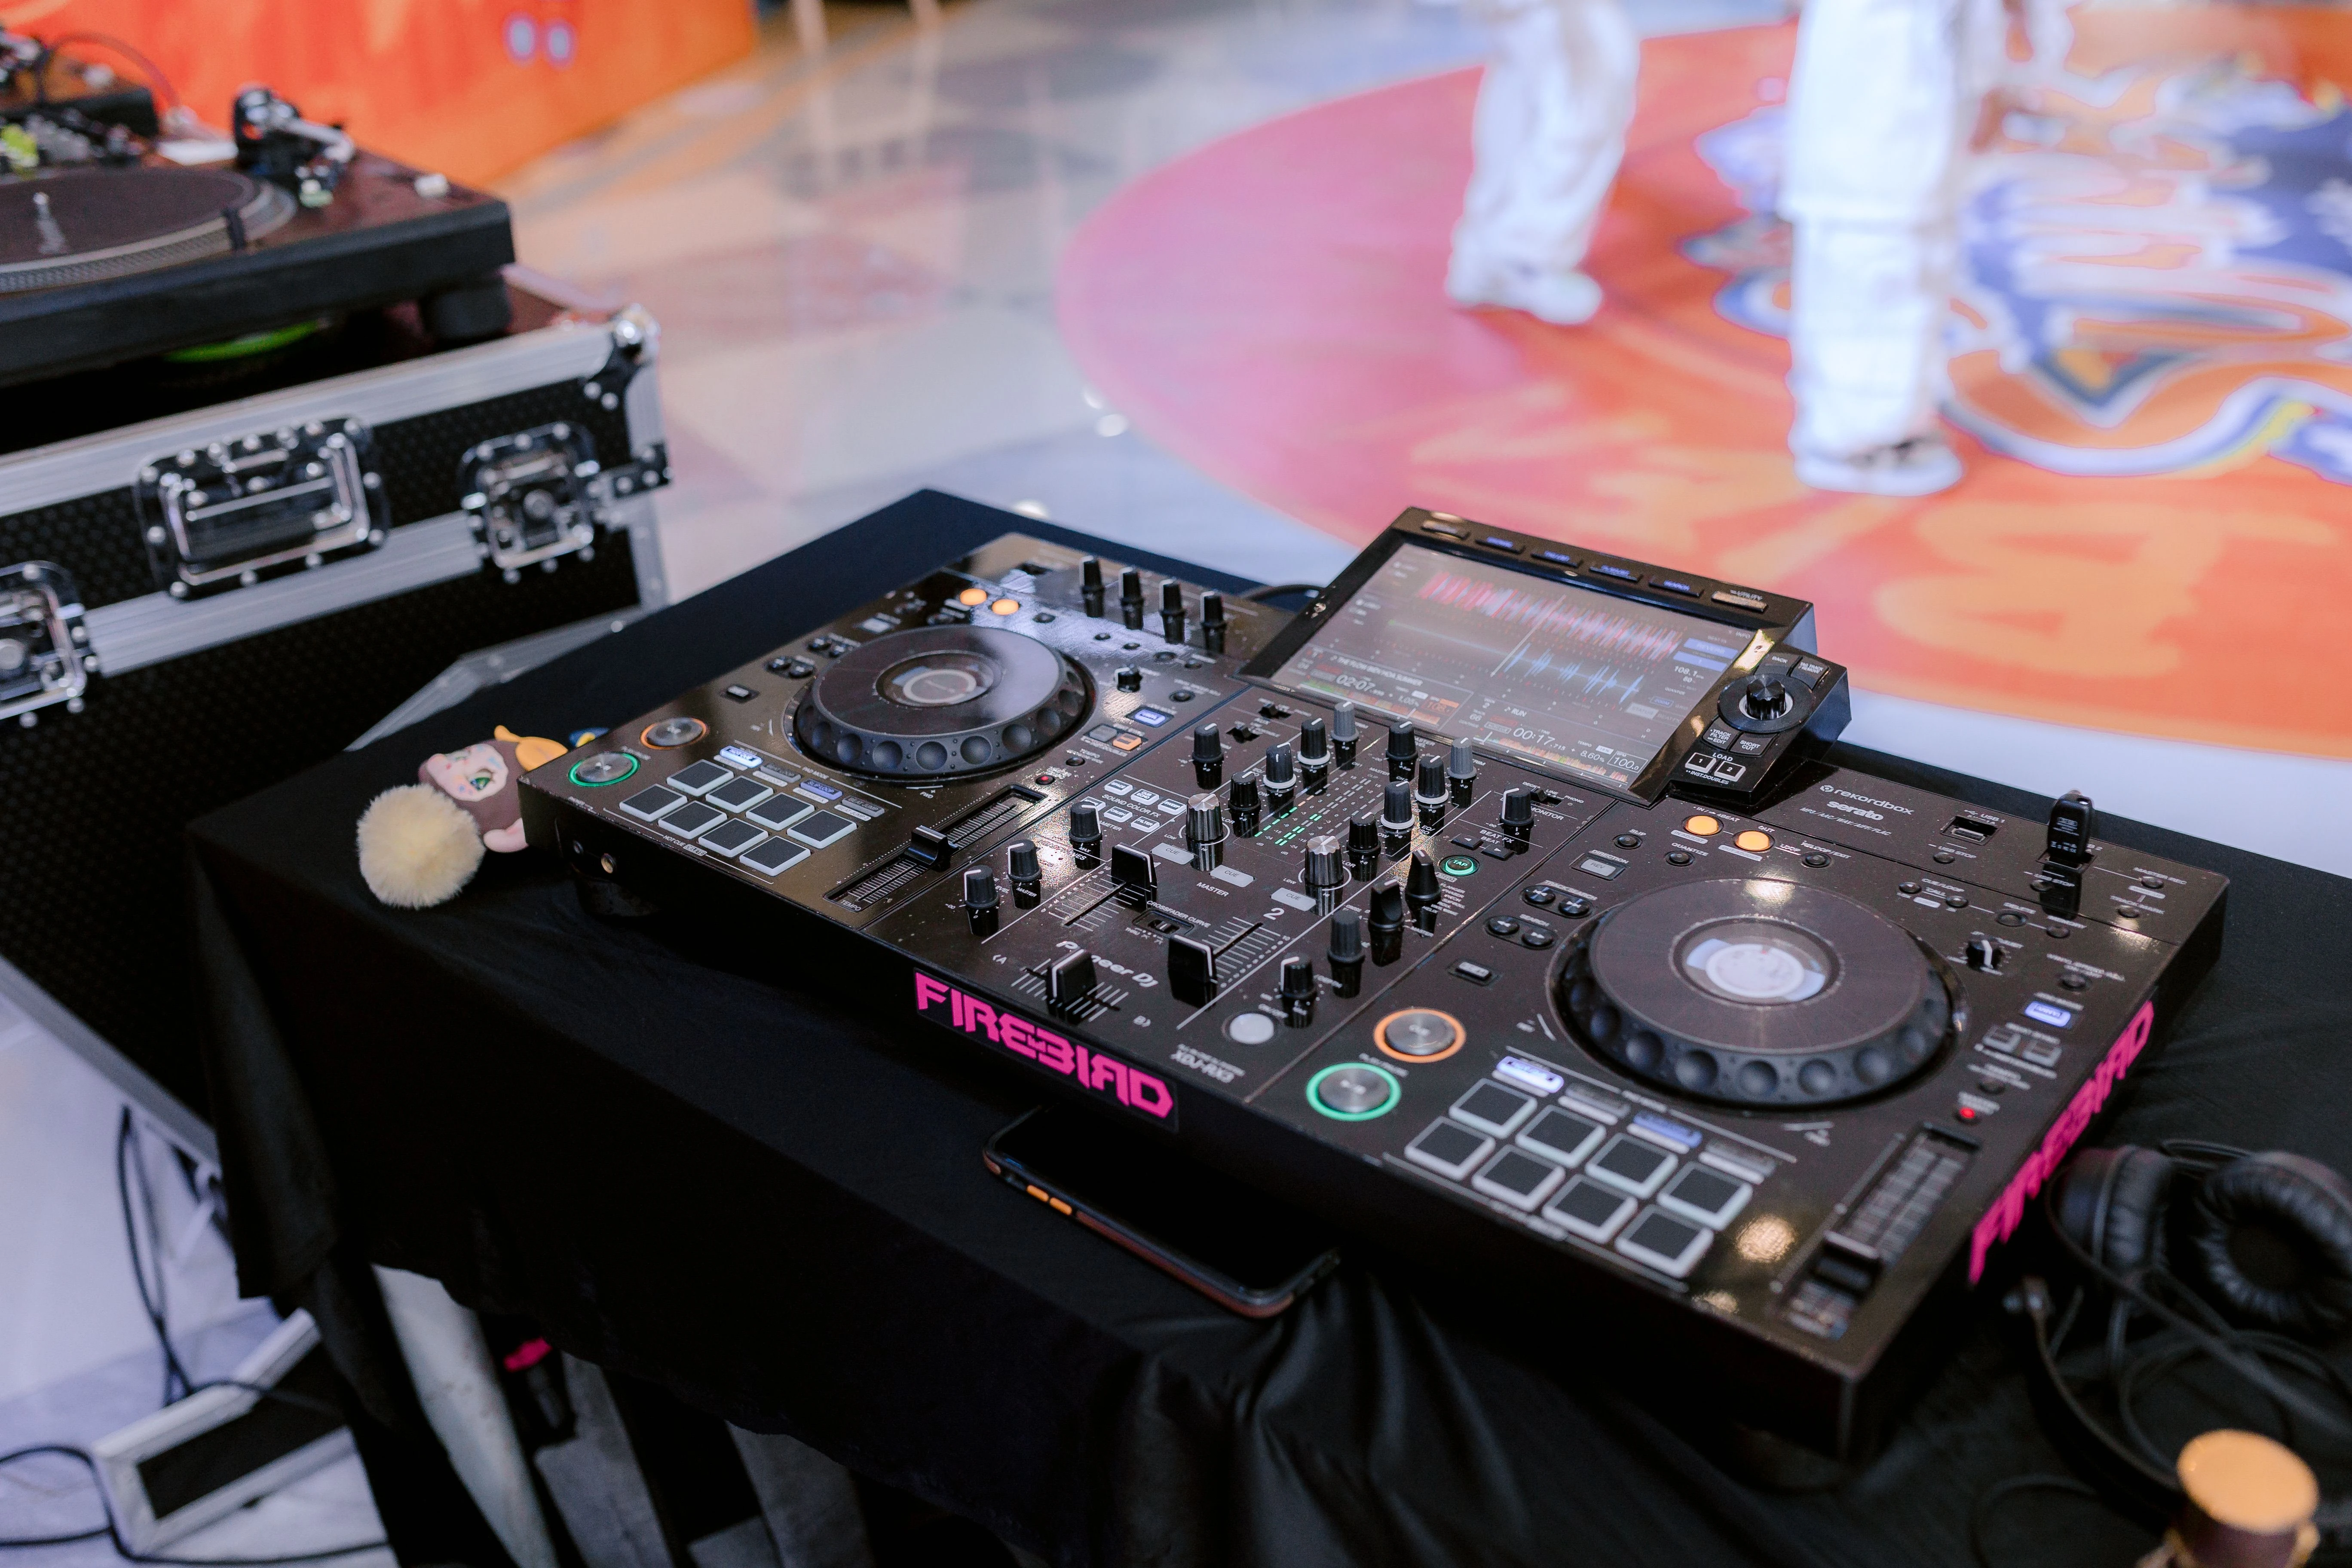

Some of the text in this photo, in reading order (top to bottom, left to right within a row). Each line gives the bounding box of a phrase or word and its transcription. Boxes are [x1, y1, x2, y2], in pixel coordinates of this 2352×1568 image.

[1710, 732, 1729, 741] FILTER
[1713, 729, 1731, 737] TRACK
[1740, 740, 1761, 748] SHORT
[1712, 752, 1733, 762] LOAD
[1614, 756, 1639, 770] 100.0
[1369, 767, 1390, 776] MASTER
[1102, 794, 1126, 805] SOUND
[1127, 803, 1152, 815] COLOR
[1564, 795, 1584, 804] PHONO
[1834, 789, 1915, 815] rekordbox
[862, 803, 879, 812] JUMP
[1164, 801, 1181, 809] SWEEP
[1531, 806, 1564, 821] MONITOR
[1827, 801, 1884, 821] serato
[1099, 821, 1122, 831] AMETER
[1479, 829, 1502, 839] BEAT
[1480, 836, 1501, 844] BEAT
[686, 844, 707, 855] DELETE
[1671, 842, 1709, 857] QUANTIZE
[1591, 849, 1629, 864] DIRECTION
[1955, 851, 1977, 859] STOP
[2052, 879, 2075, 887] STOP
[995, 885, 1010, 894] EVEL
[1016, 887, 1037, 897] MASTER
[1196, 882, 1229, 897] MASTER
[840, 899, 862, 911] TEMPO
[1146, 900, 1211, 928] CROSSFADER CURVE
[1263, 907, 1285, 920] 2
[1056, 940, 1159, 988] Pneer DJ
